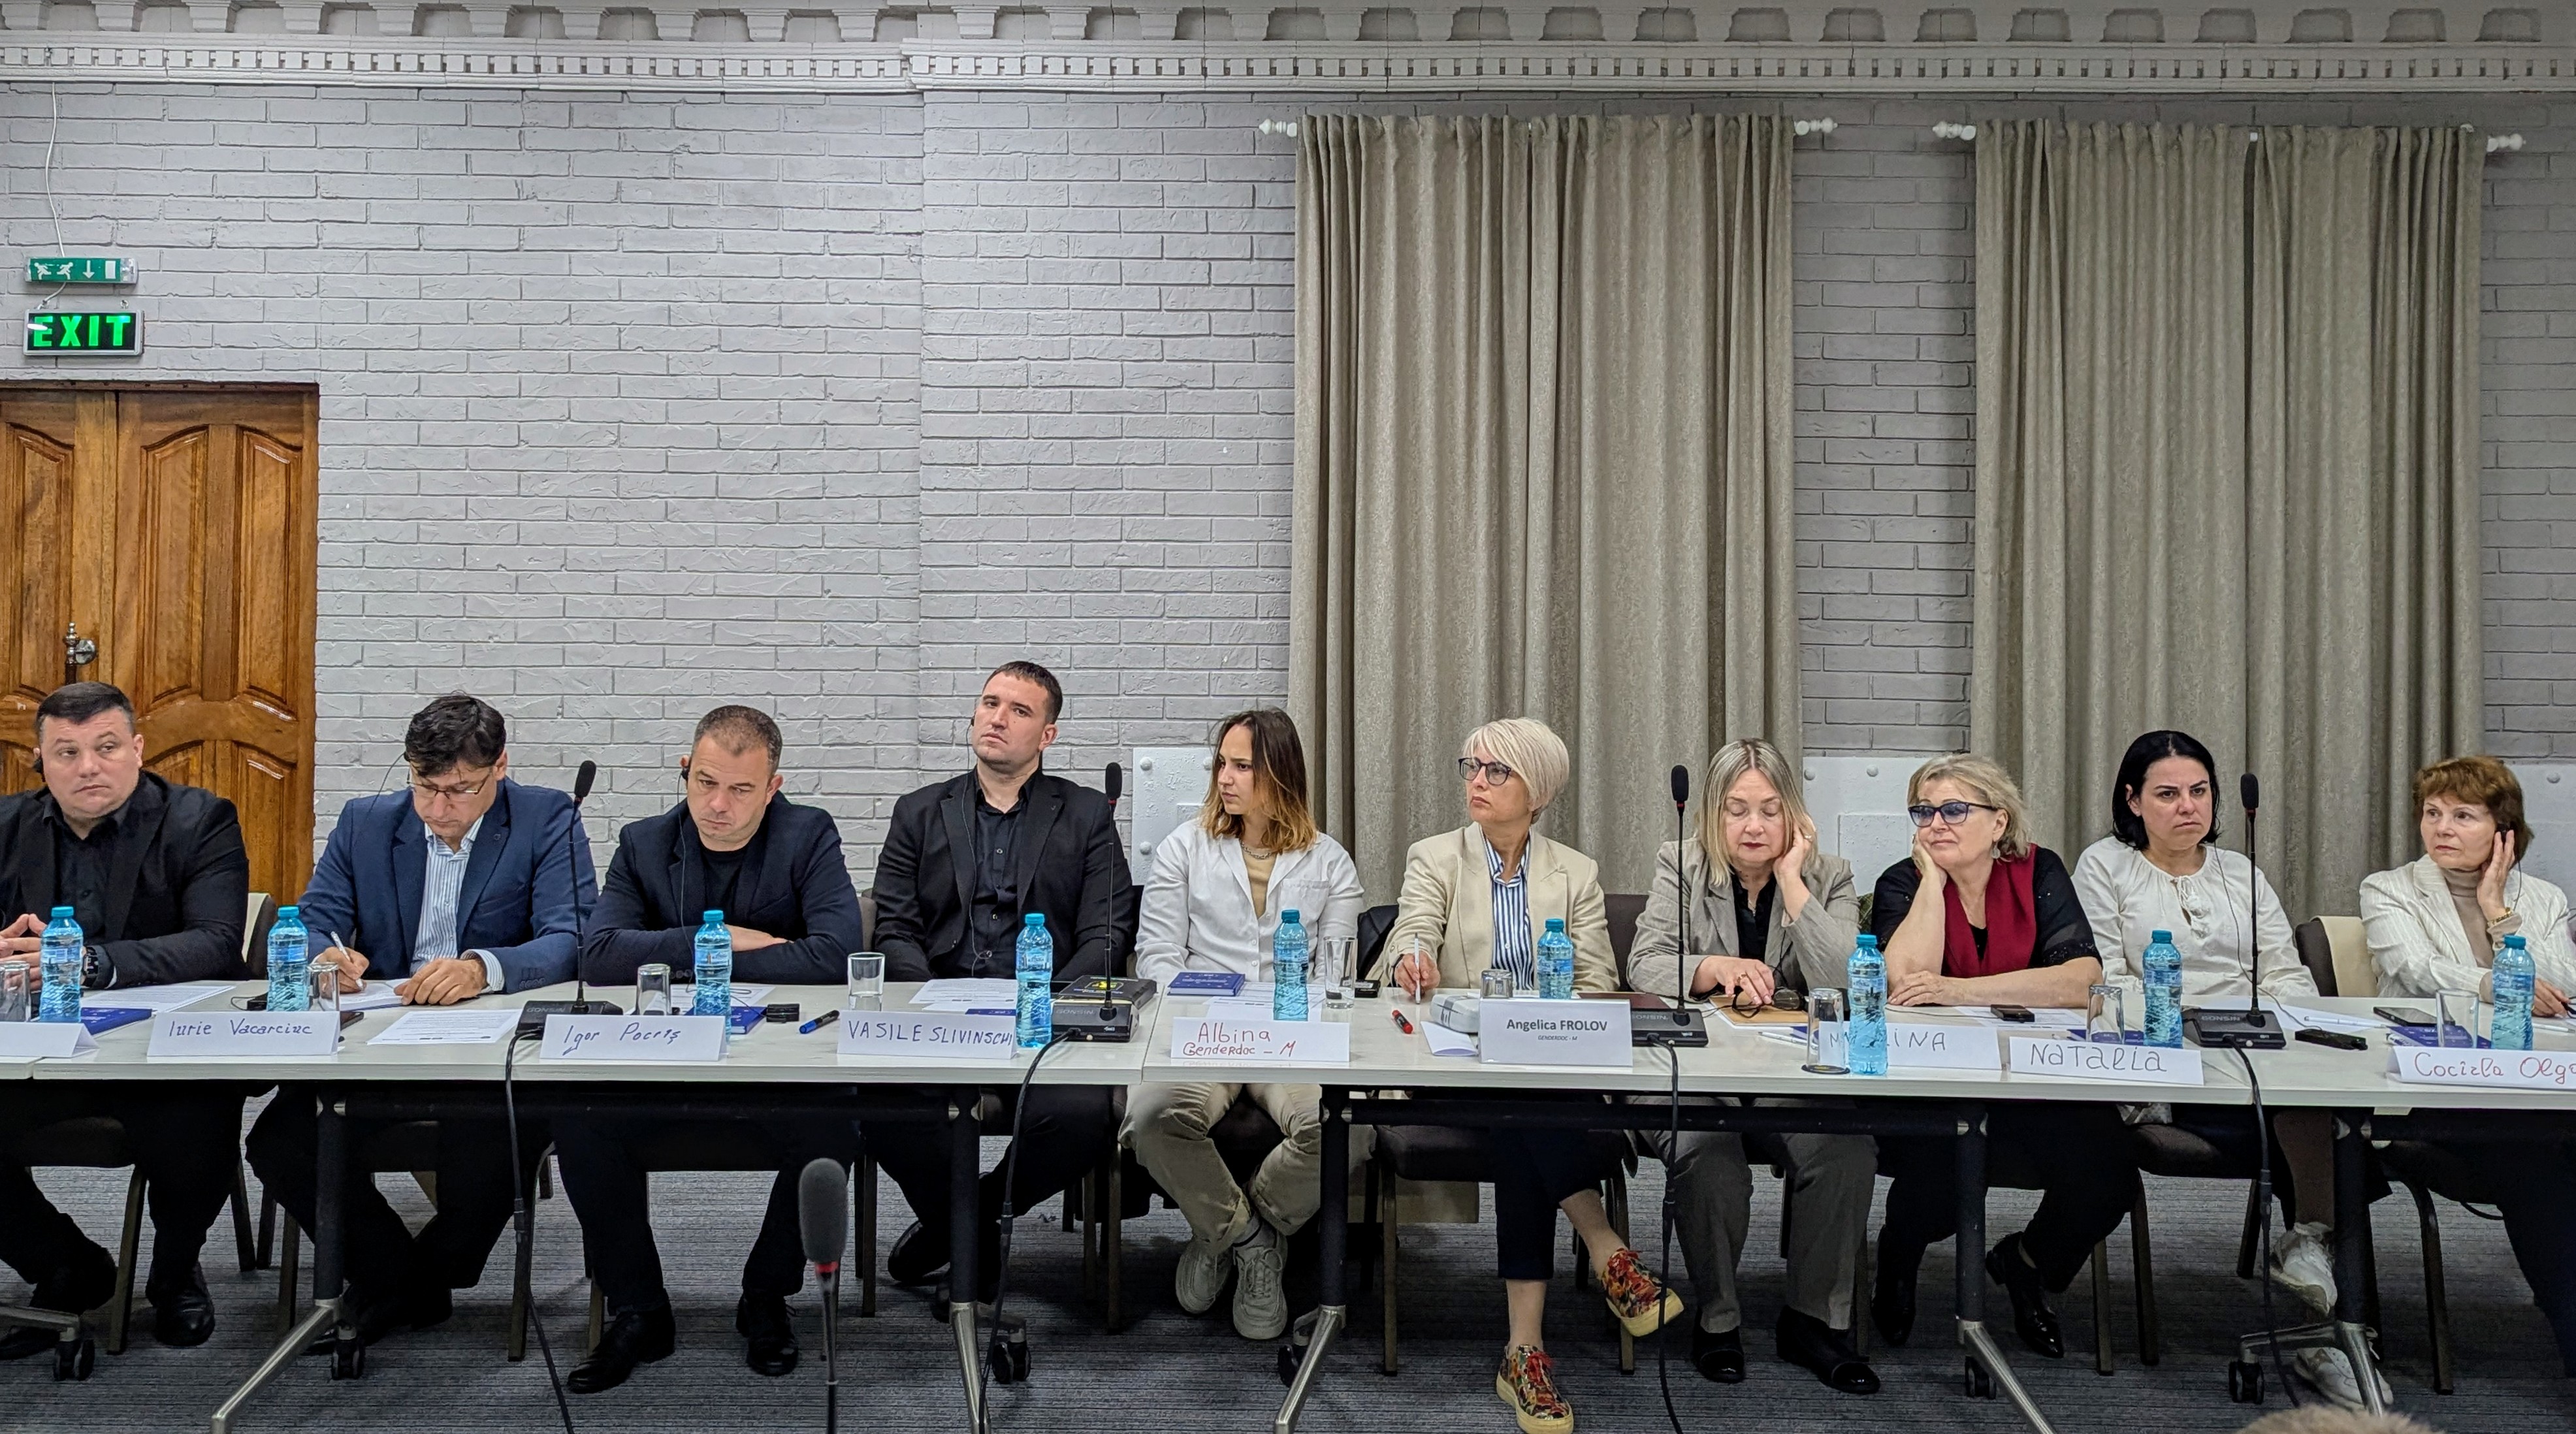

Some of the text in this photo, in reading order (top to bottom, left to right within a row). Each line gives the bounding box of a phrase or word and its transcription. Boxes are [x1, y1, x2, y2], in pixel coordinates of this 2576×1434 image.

[33, 315, 131, 347] EXIT
[169, 1018, 313, 1037] Iurie Vacarciuc
[848, 1020, 1012, 1046] VASILE SLIVINSCHI
[1198, 1022, 1271, 1044] Albina
[1506, 1019, 1607, 1032] Angelica FROLOV
[562, 1025, 601, 1056] Igor
[1279, 1040, 1296, 1057] M
